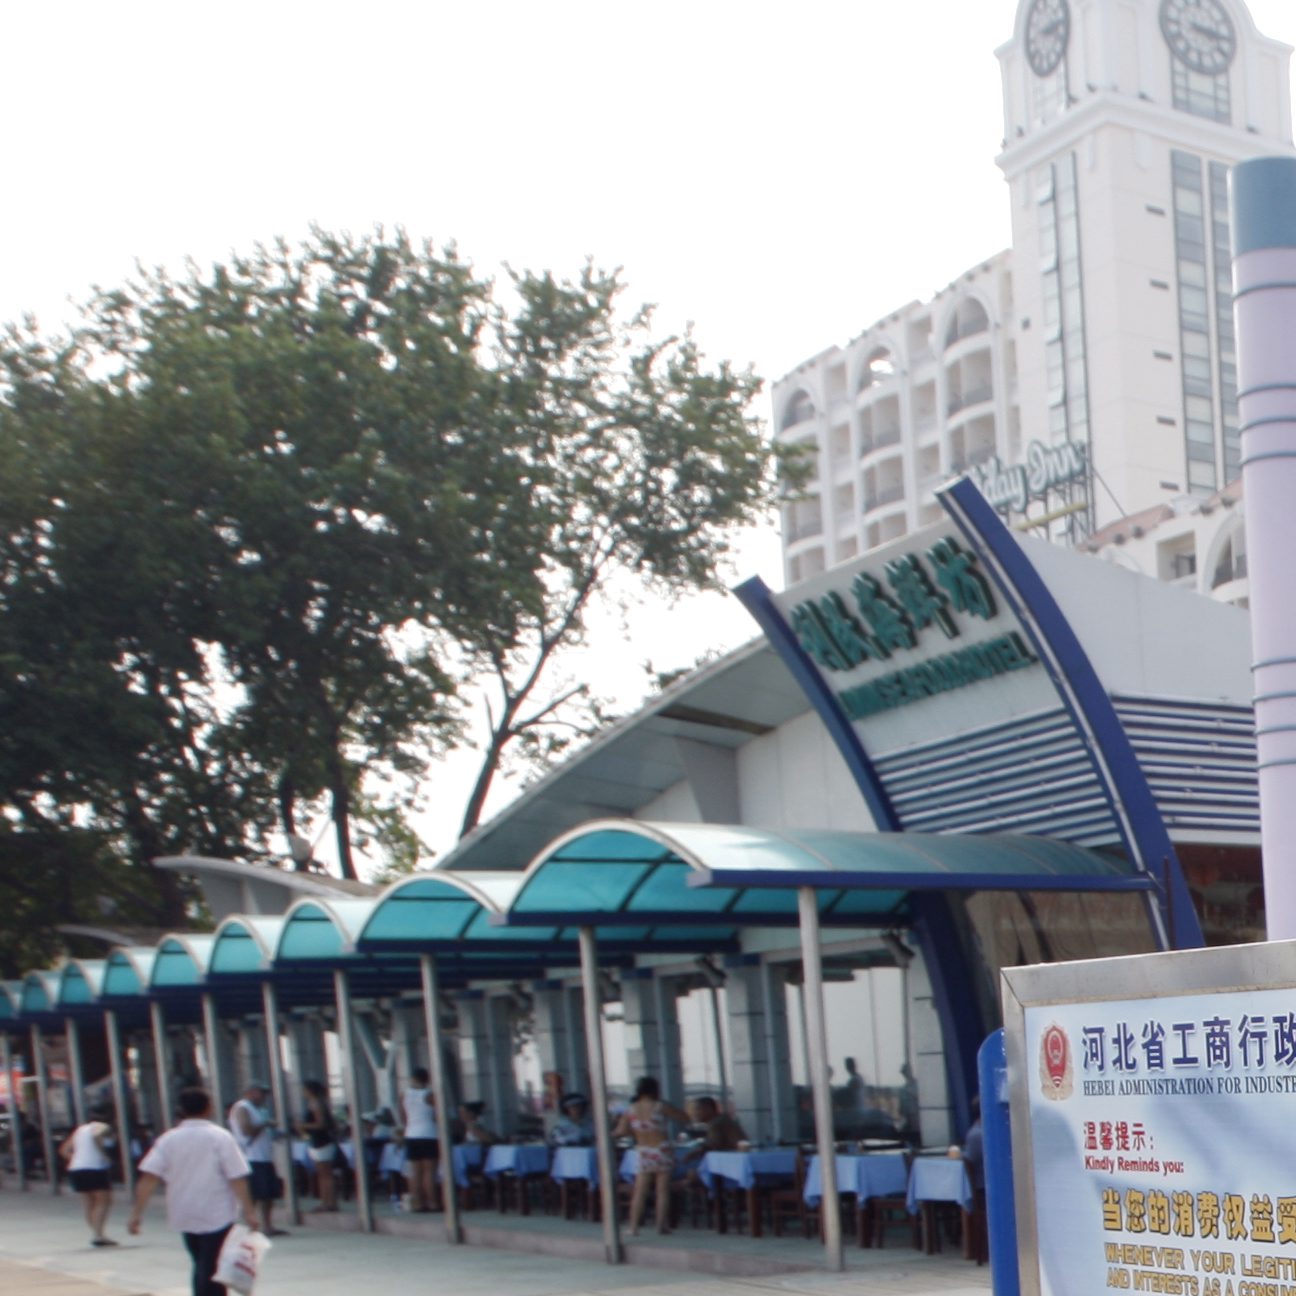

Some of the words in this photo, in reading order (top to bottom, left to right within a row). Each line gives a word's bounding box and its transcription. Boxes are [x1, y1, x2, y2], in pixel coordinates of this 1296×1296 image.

[1083, 1080, 1115, 1096] HEBEI
[1118, 1077, 1214, 1096] ADMINISTRATION
[1217, 1077, 1242, 1094] FOR
[1085, 1155, 1115, 1174] Kindly
[1118, 1156, 1160, 1173] Reminds
[1162, 1161, 1184, 1176] you:
[1104, 1241, 1185, 1270] WHENEVER
[1190, 1249, 1236, 1275] YOUR
[1106, 1267, 1130, 1289] AND
